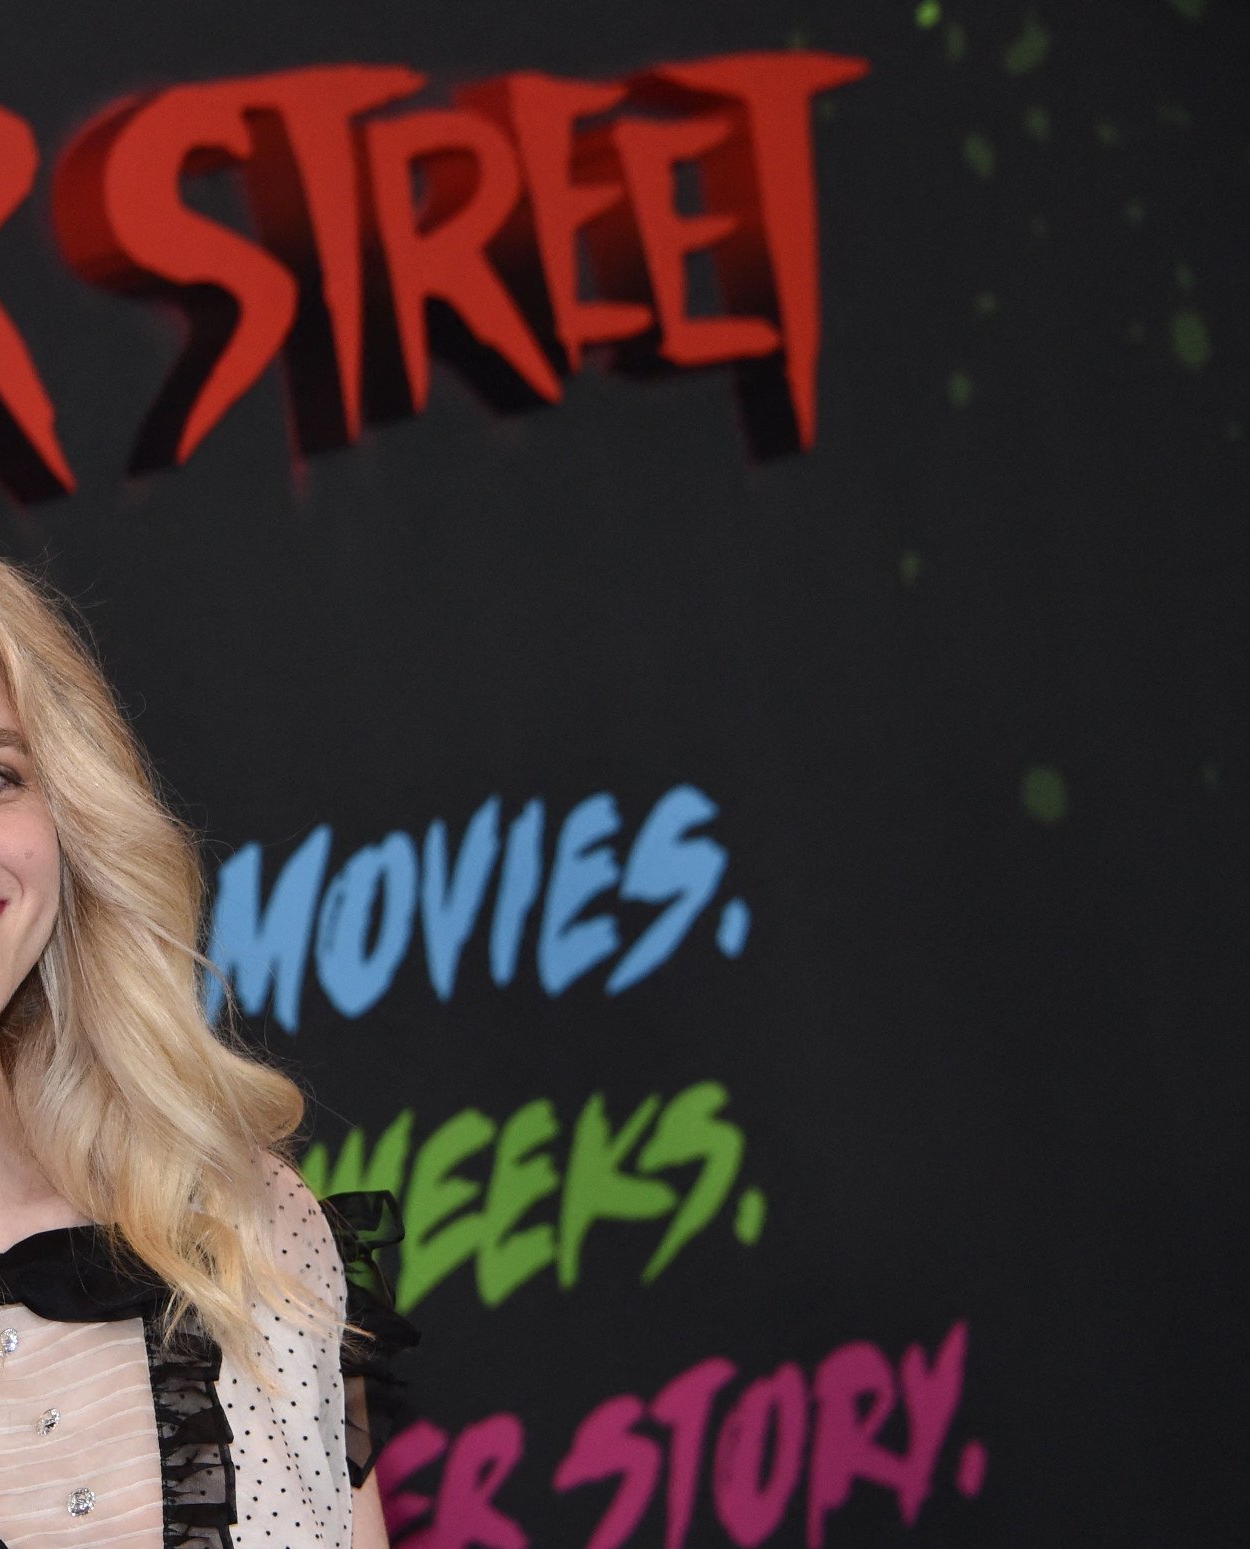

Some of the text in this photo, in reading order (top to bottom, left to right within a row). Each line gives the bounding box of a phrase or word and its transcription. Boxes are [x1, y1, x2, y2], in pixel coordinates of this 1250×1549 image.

[54, 51, 870, 465] STREET
[204, 783, 751, 1035] MOVIES.
[553, 1320, 987, 1549] STORY.
